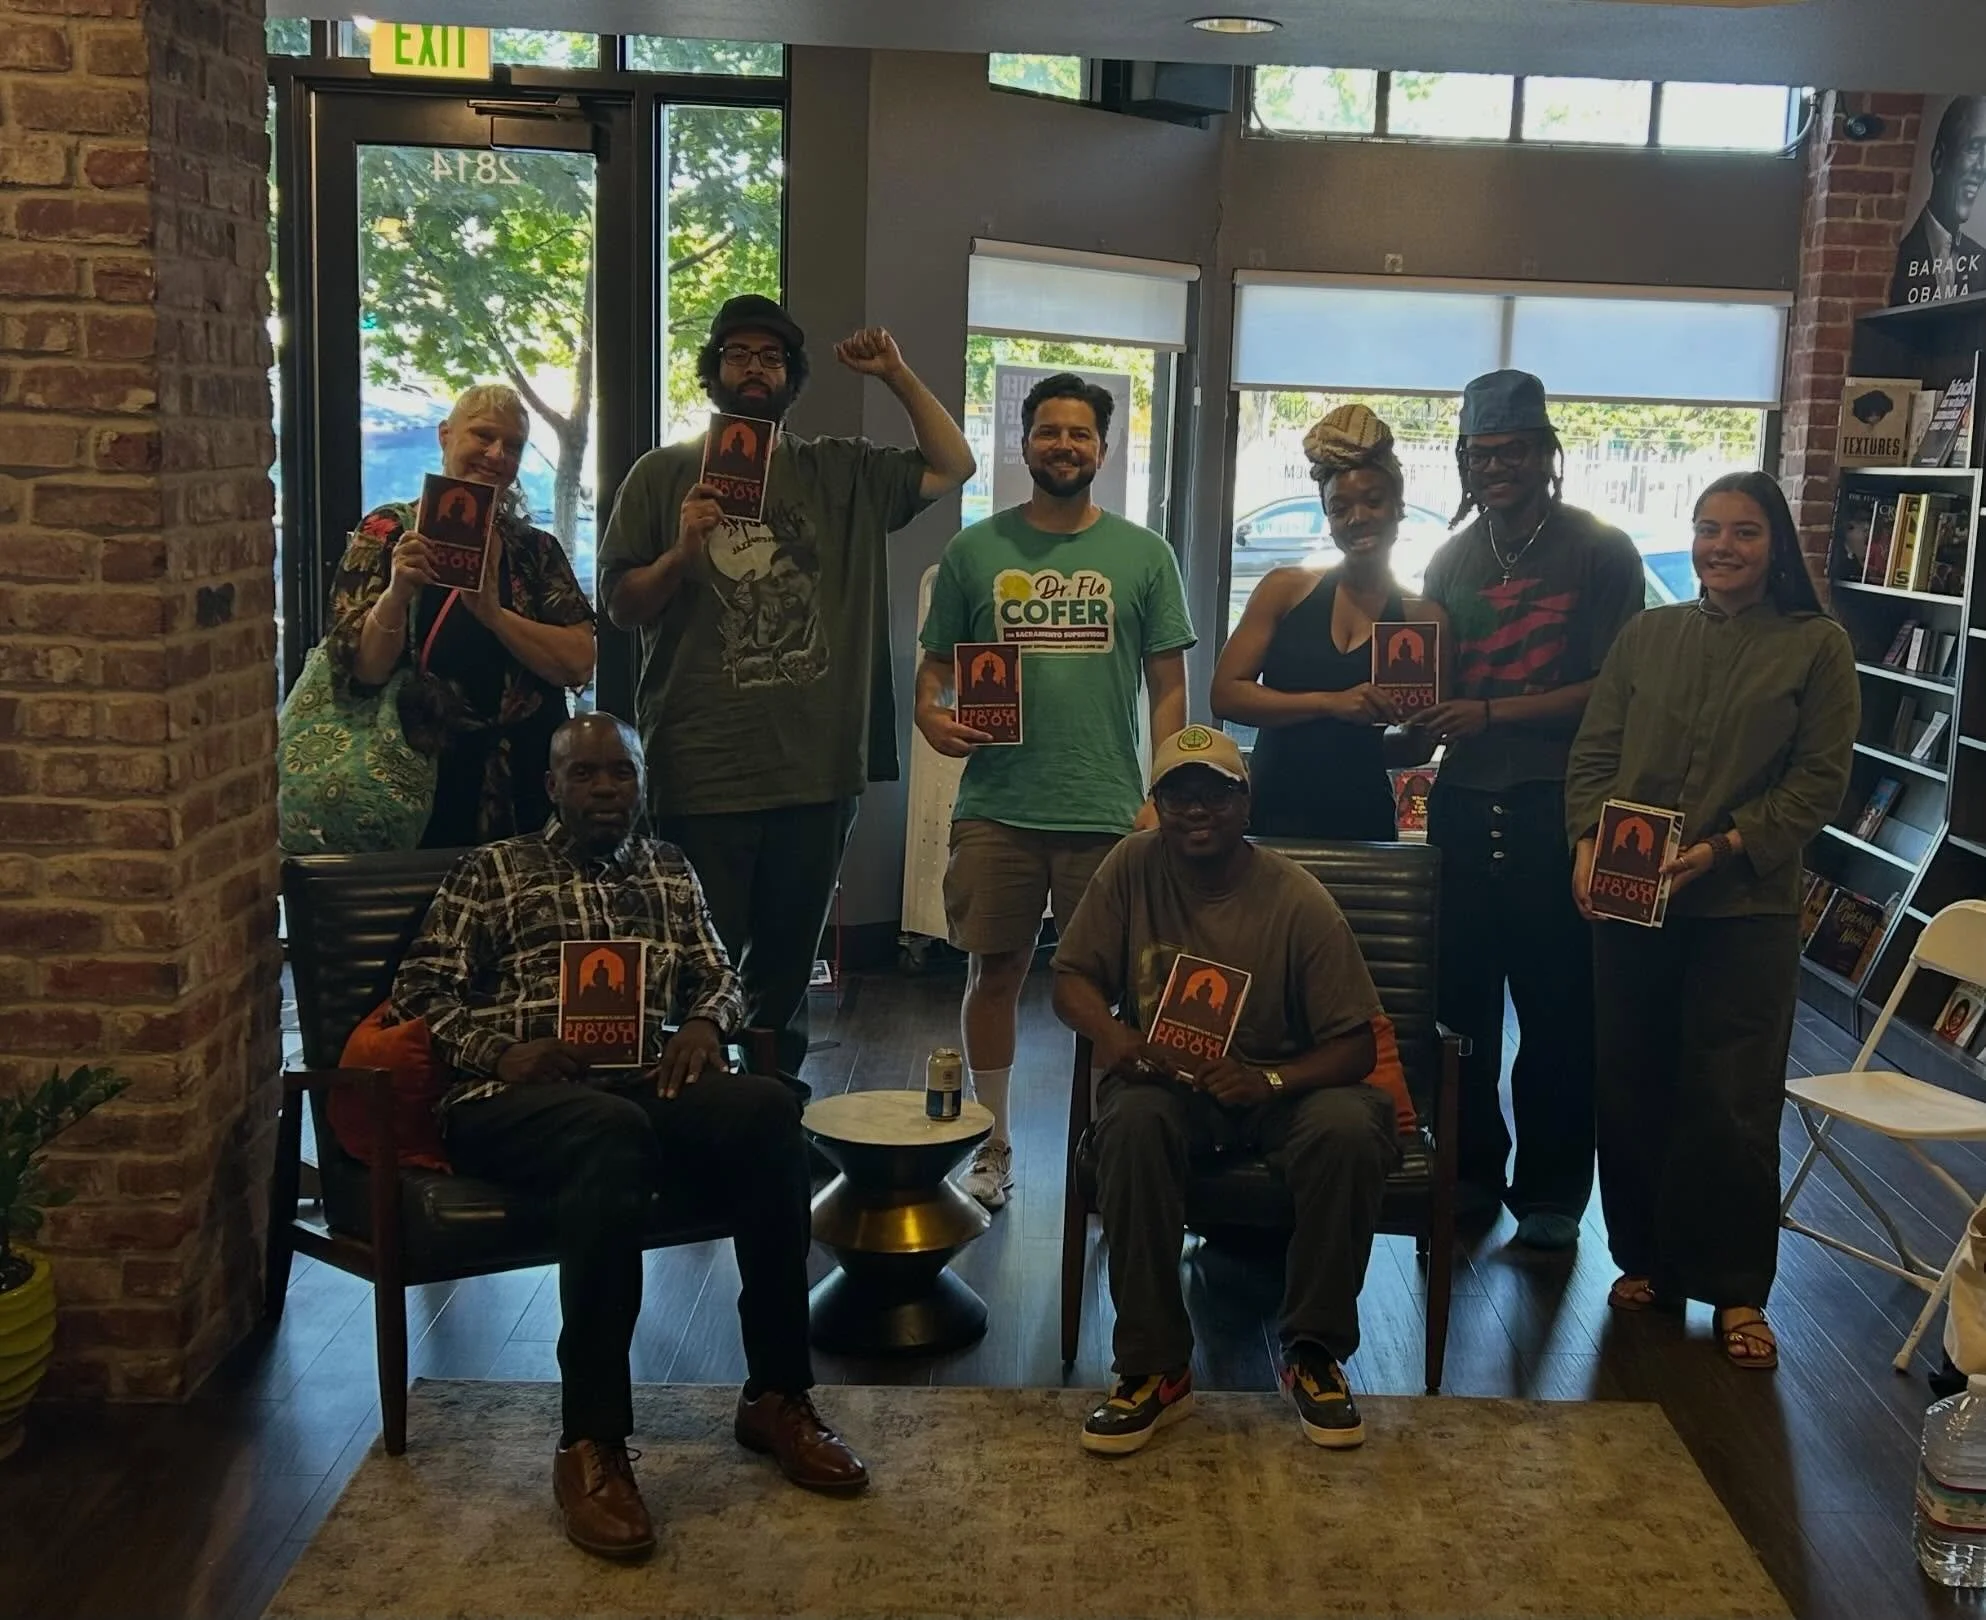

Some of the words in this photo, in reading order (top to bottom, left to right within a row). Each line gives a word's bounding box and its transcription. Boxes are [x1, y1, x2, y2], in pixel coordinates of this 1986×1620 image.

[395, 24, 465, 68] EXIT
[1908, 254, 1981, 278] BARACK
[1907, 283, 1969, 304] OBAMA
[1843, 436, 1901, 457] TEXTURES
[1035, 575, 1071, 599] Dr.
[1077, 576, 1105, 598] Flo
[1001, 599, 1108, 625] COFER
